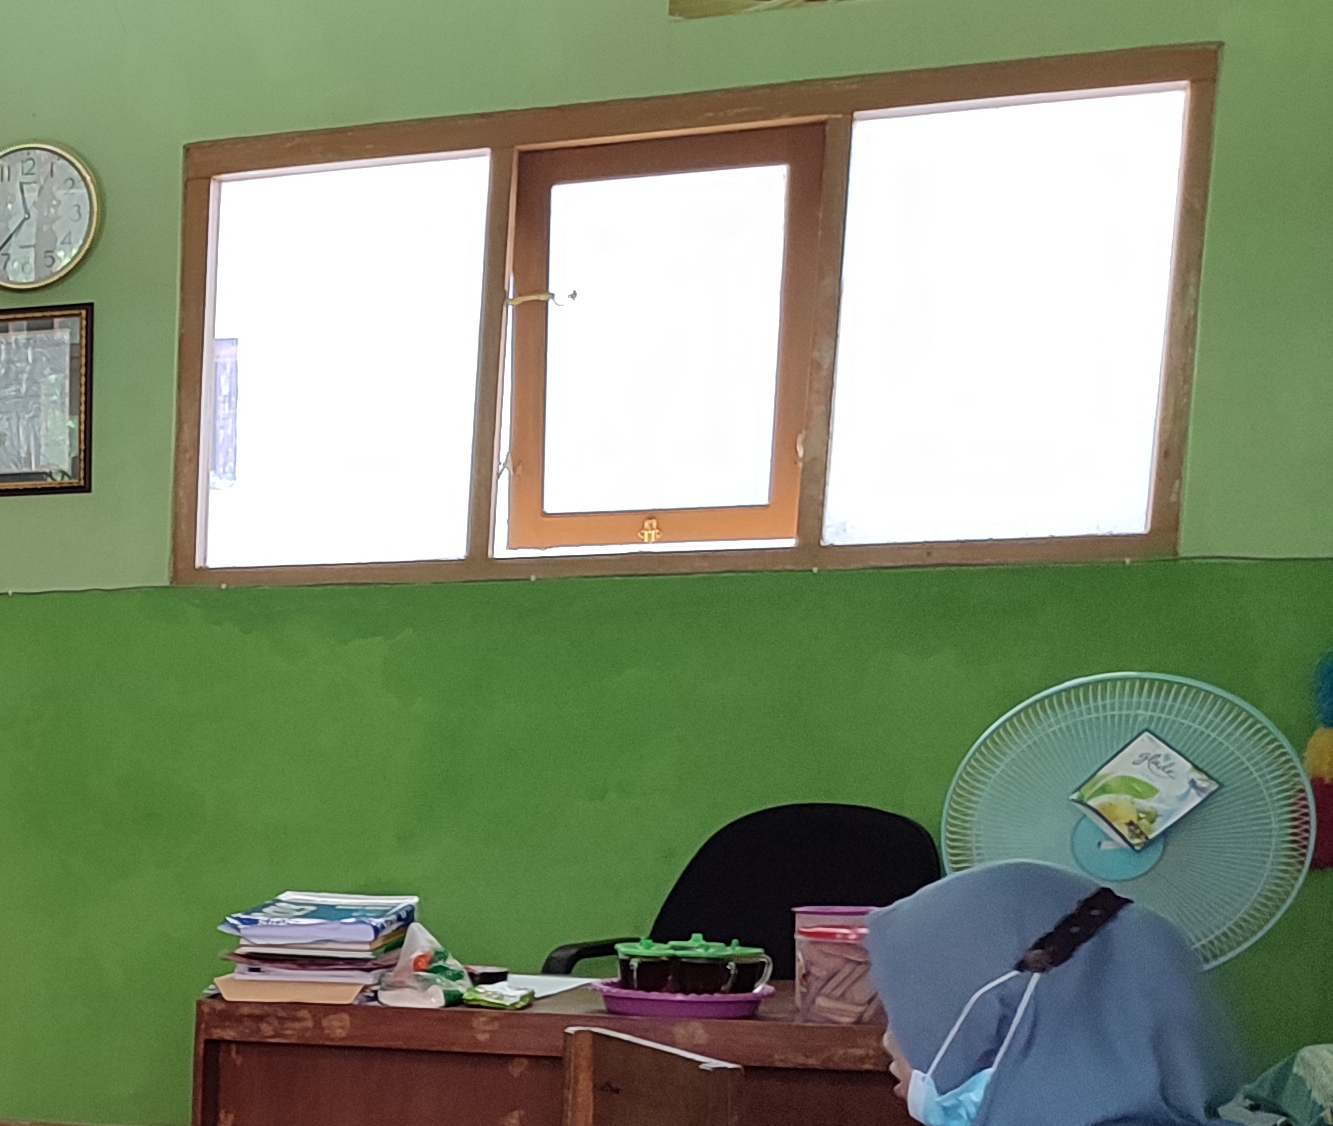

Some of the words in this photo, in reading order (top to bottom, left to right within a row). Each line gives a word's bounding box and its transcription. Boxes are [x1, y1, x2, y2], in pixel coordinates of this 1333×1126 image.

[0, 165, 11, 182] 11
[21, 158, 36, 176] 12
[63, 177, 75, 195] 2
[70, 203, 82, 223] 3
[60, 231, 72, 245] 4
[1, 252, 11, 271] 7
[43, 250, 56, 268] 5
[1131, 752, 1176, 780] glade
